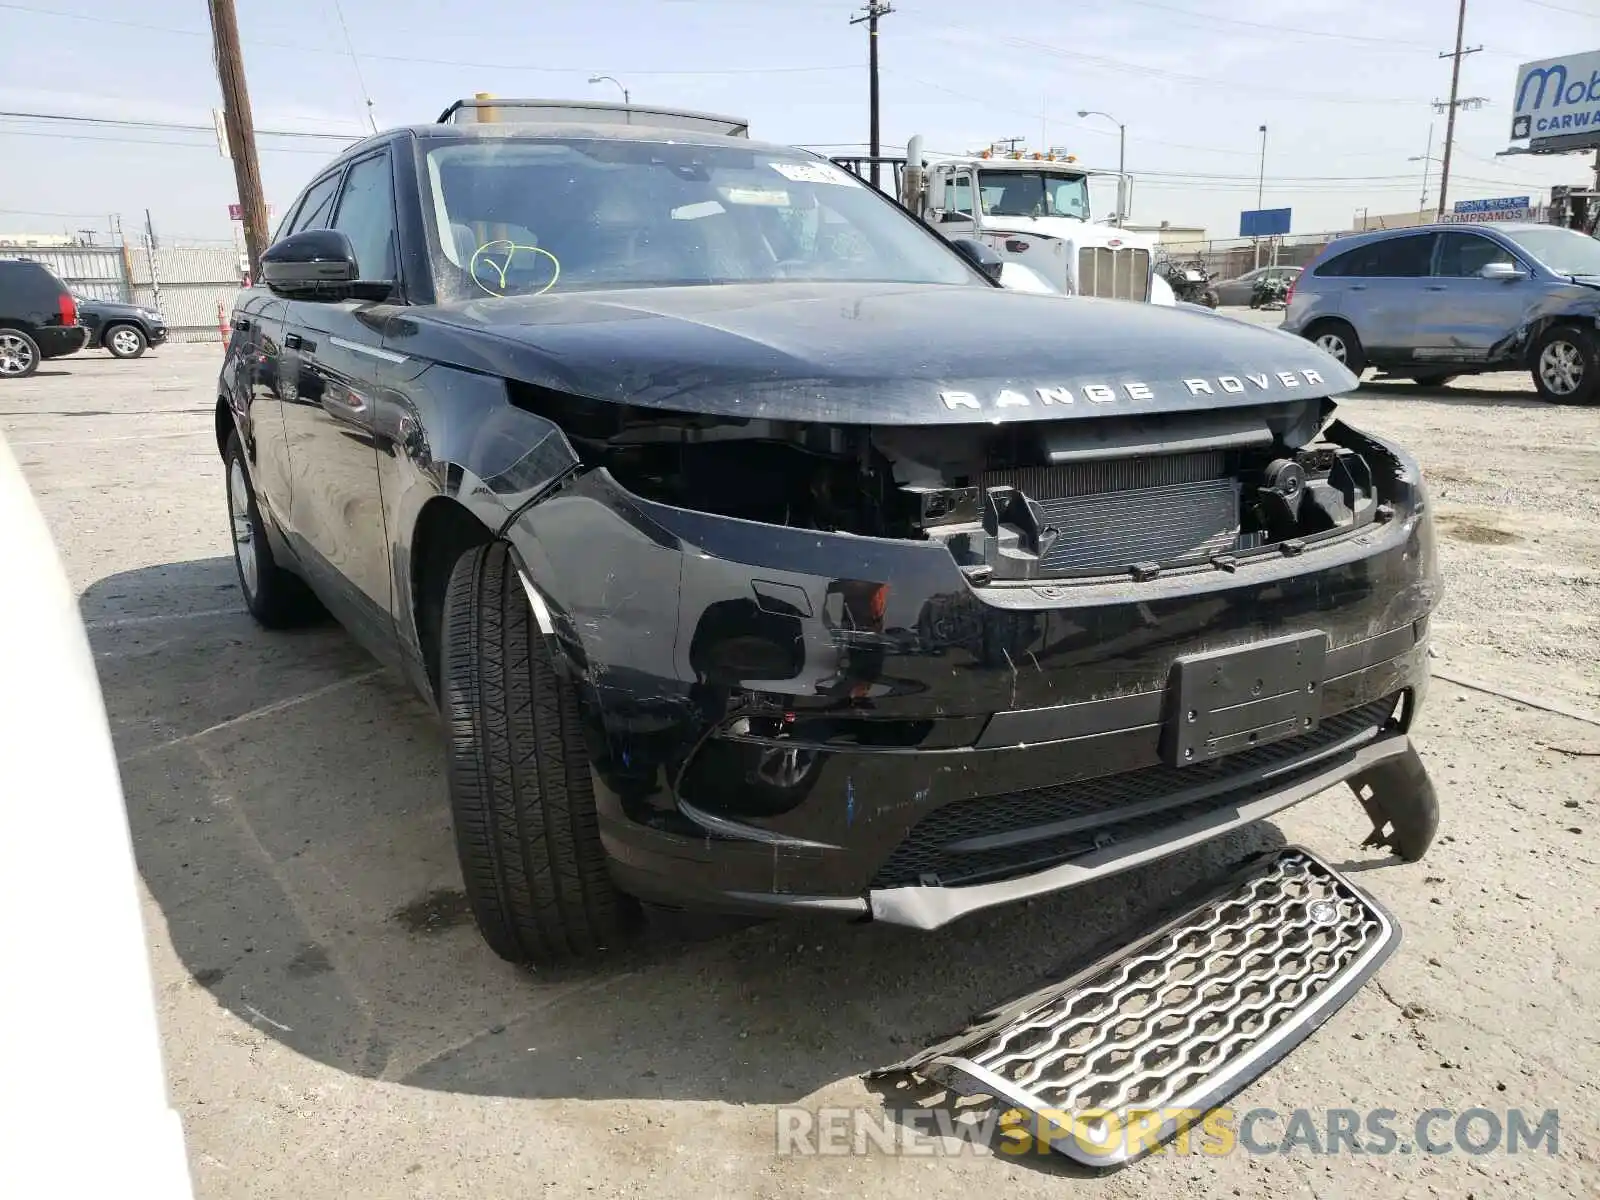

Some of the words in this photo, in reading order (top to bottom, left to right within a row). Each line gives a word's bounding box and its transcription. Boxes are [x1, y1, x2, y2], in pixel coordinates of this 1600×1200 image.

[1445, 209, 1522, 224] COMPRAMOS
[939, 382, 1154, 411] RANGE
[1183, 368, 1325, 396] ROVER
